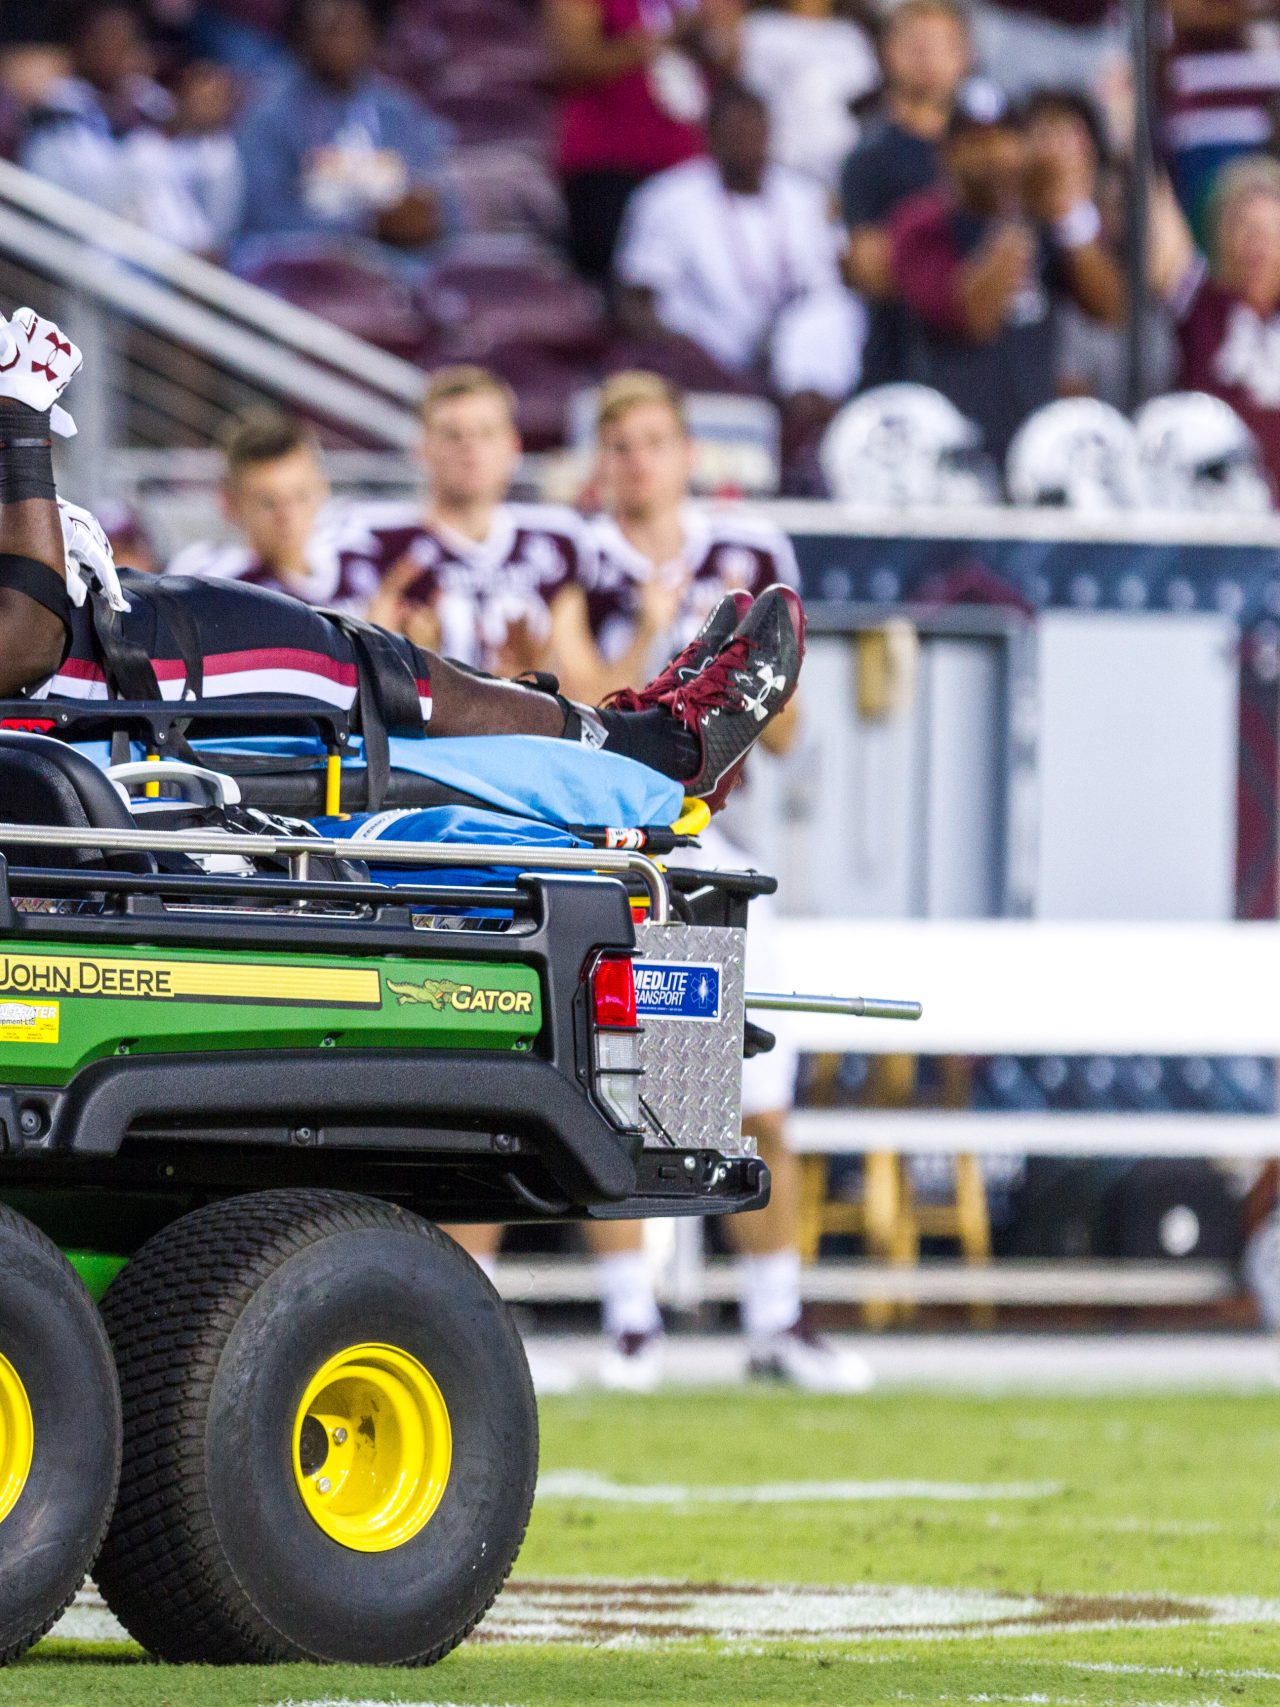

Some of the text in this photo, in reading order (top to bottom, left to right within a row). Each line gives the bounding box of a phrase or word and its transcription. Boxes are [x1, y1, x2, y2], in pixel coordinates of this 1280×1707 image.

[79, 962, 172, 993] DEERE
[632, 969, 689, 991] MEDLITE
[451, 985, 532, 1012] GATOR
[634, 990, 686, 1006] RANSPORT
